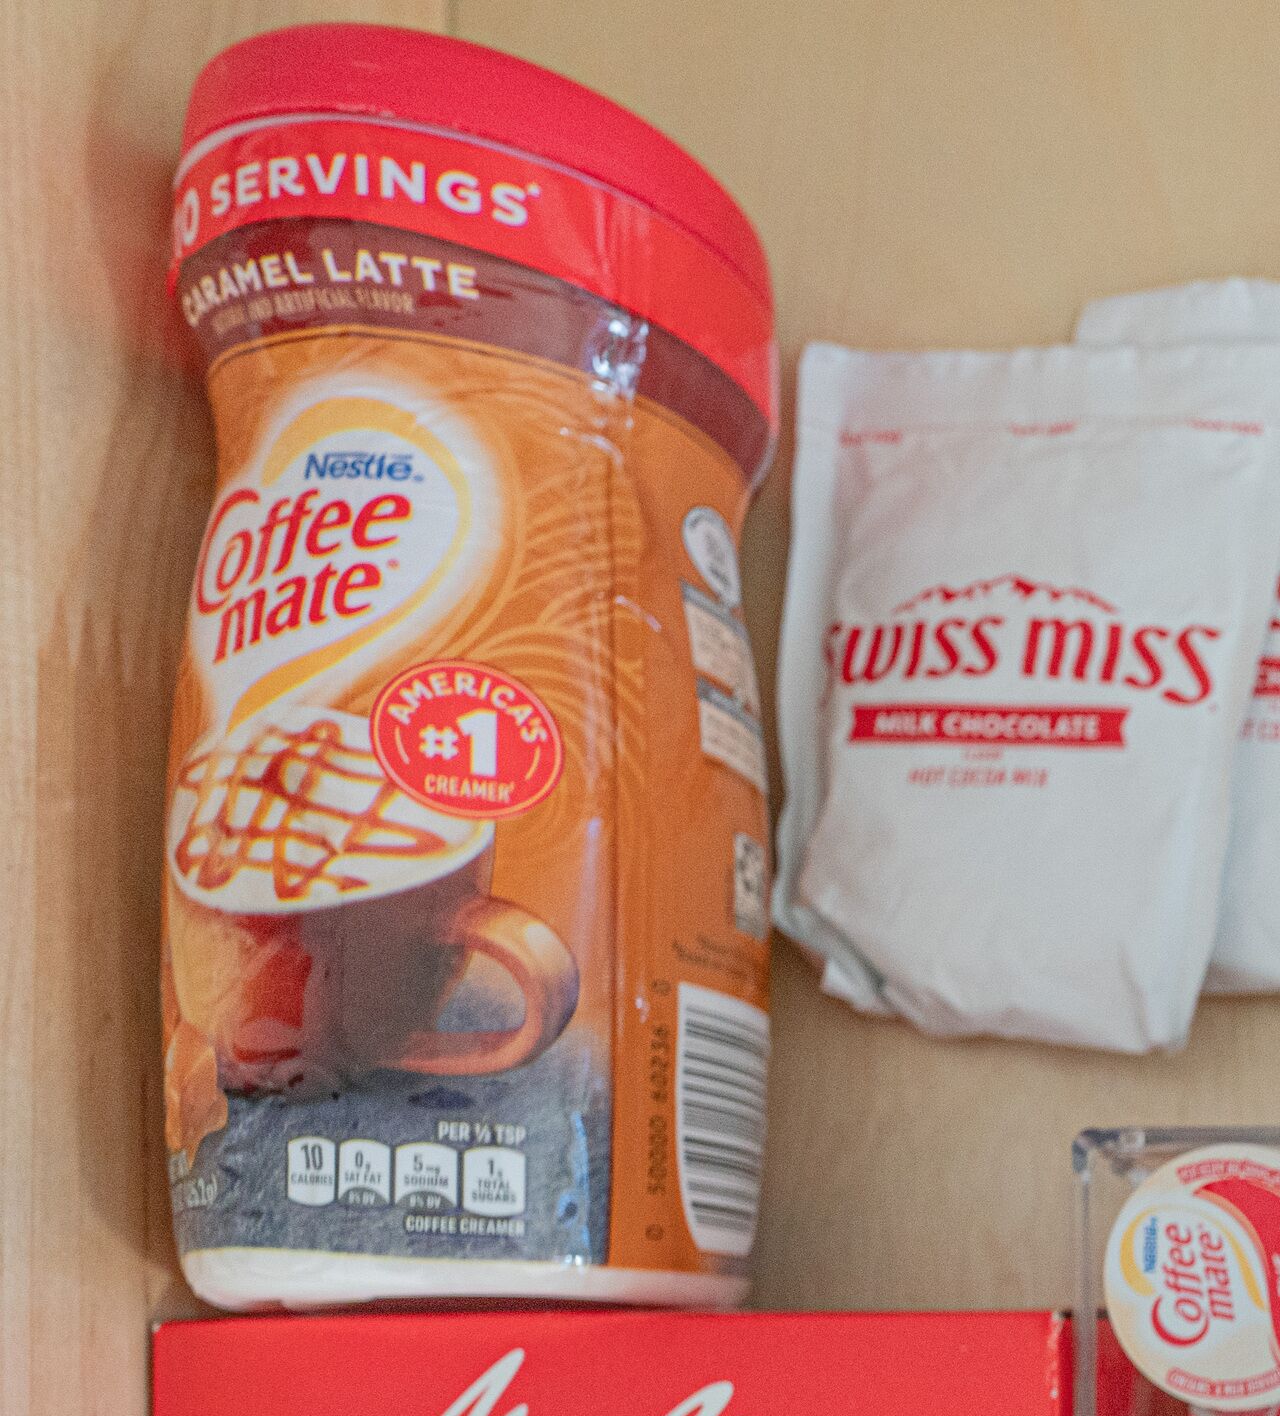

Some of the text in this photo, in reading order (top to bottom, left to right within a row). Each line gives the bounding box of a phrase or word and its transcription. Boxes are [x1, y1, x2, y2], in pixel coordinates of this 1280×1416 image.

[182, 251, 315, 328] CARAMEL
[322, 249, 479, 299] LATTE
[198, 488, 413, 611] Coffee
[212, 558, 382, 664] mate
[388, 671, 547, 744] AMERICA'S
[874, 713, 1099, 739] MILK CHOCOLATE
[419, 708, 498, 777] #1
[424, 774, 512, 803] CREAMER
[301, 1144, 323, 1170] 10
[438, 1121, 526, 1145] PER TSP
[291, 1174, 334, 1185] CALORIES
[404, 1175, 448, 1186] SODIUM
[406, 1215, 526, 1236] COFFEE CREAMER
[1151, 1223, 1208, 1349] Coffee
[1206, 1231, 1239, 1324] mate
